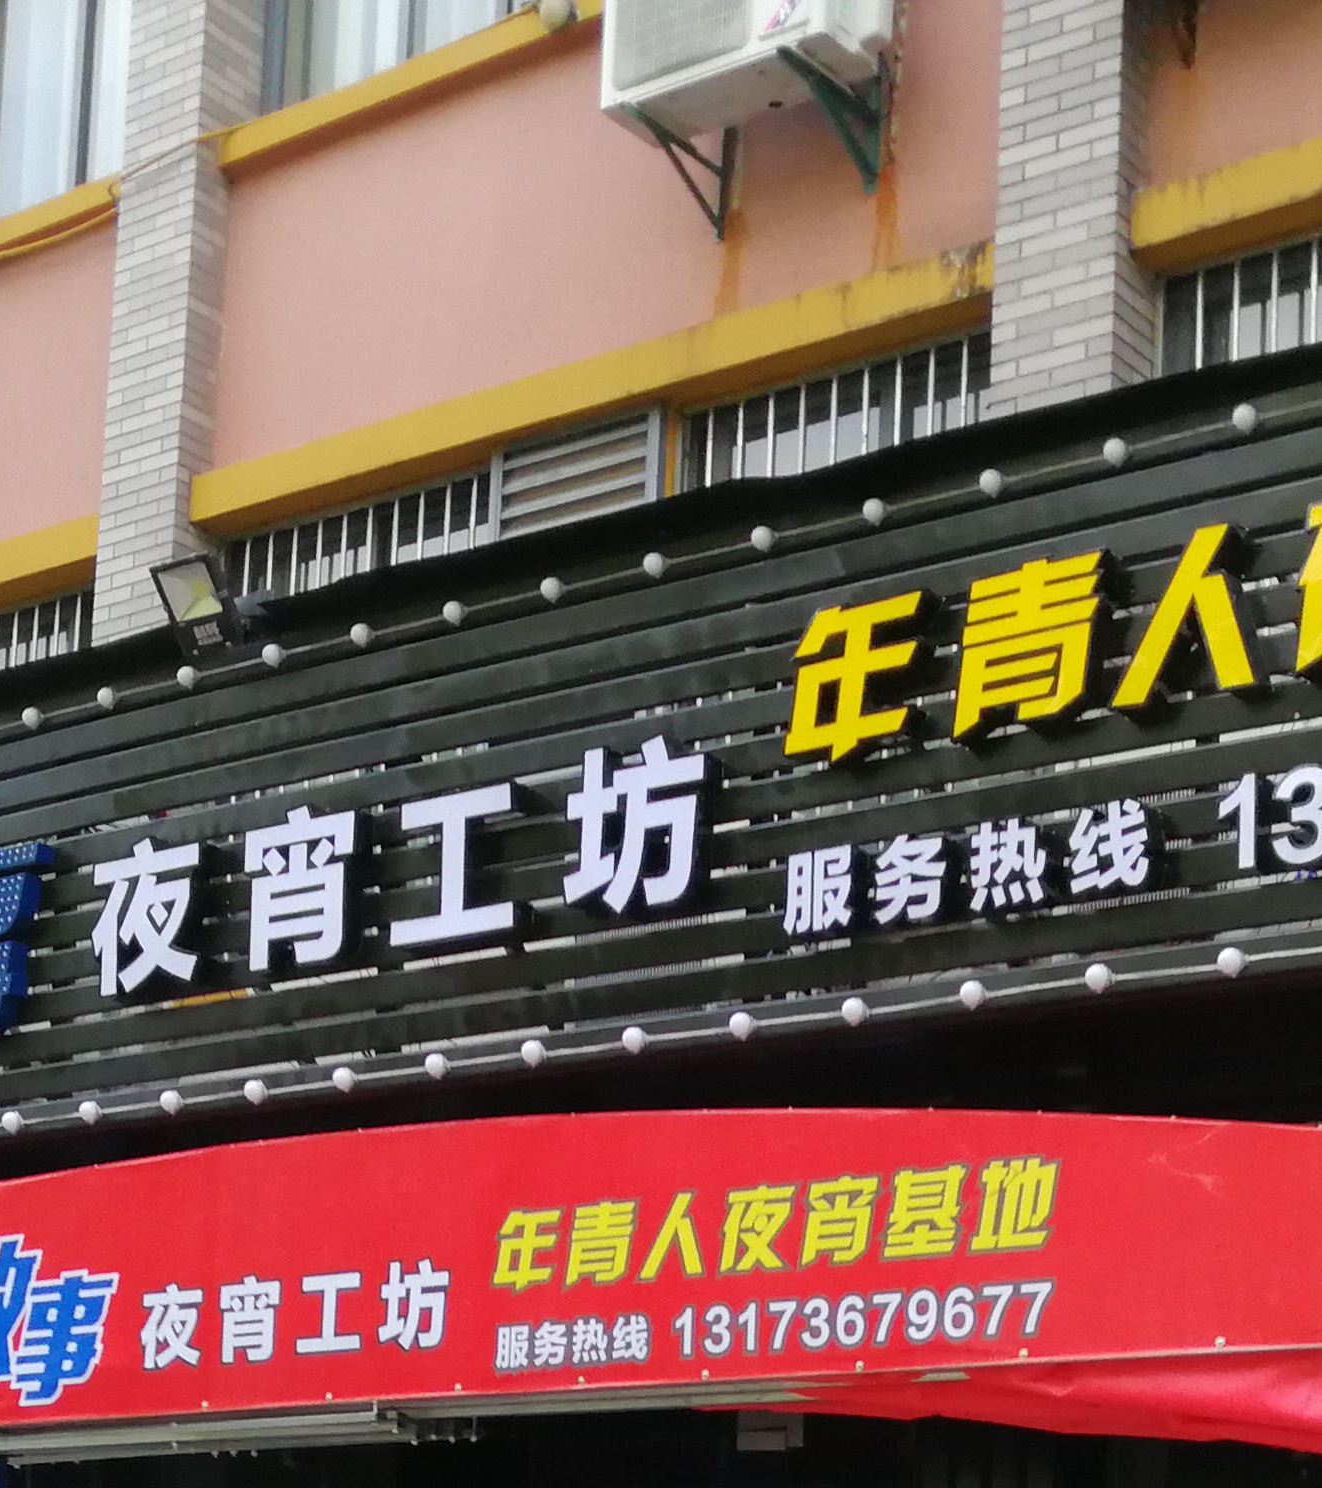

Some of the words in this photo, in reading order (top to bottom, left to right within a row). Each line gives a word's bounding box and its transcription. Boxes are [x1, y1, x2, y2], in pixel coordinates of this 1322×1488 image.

[91, 735, 708, 998] 夜宵工坊
[783, 799, 1150, 936] 服务热线
[492, 1157, 1059, 1293] 年青人夜宵基地
[139, 1258, 451, 1370] 夜宵工坊
[494, 1315, 651, 1370] 服务热线
[674, 1282, 1054, 1357] 13173679677
